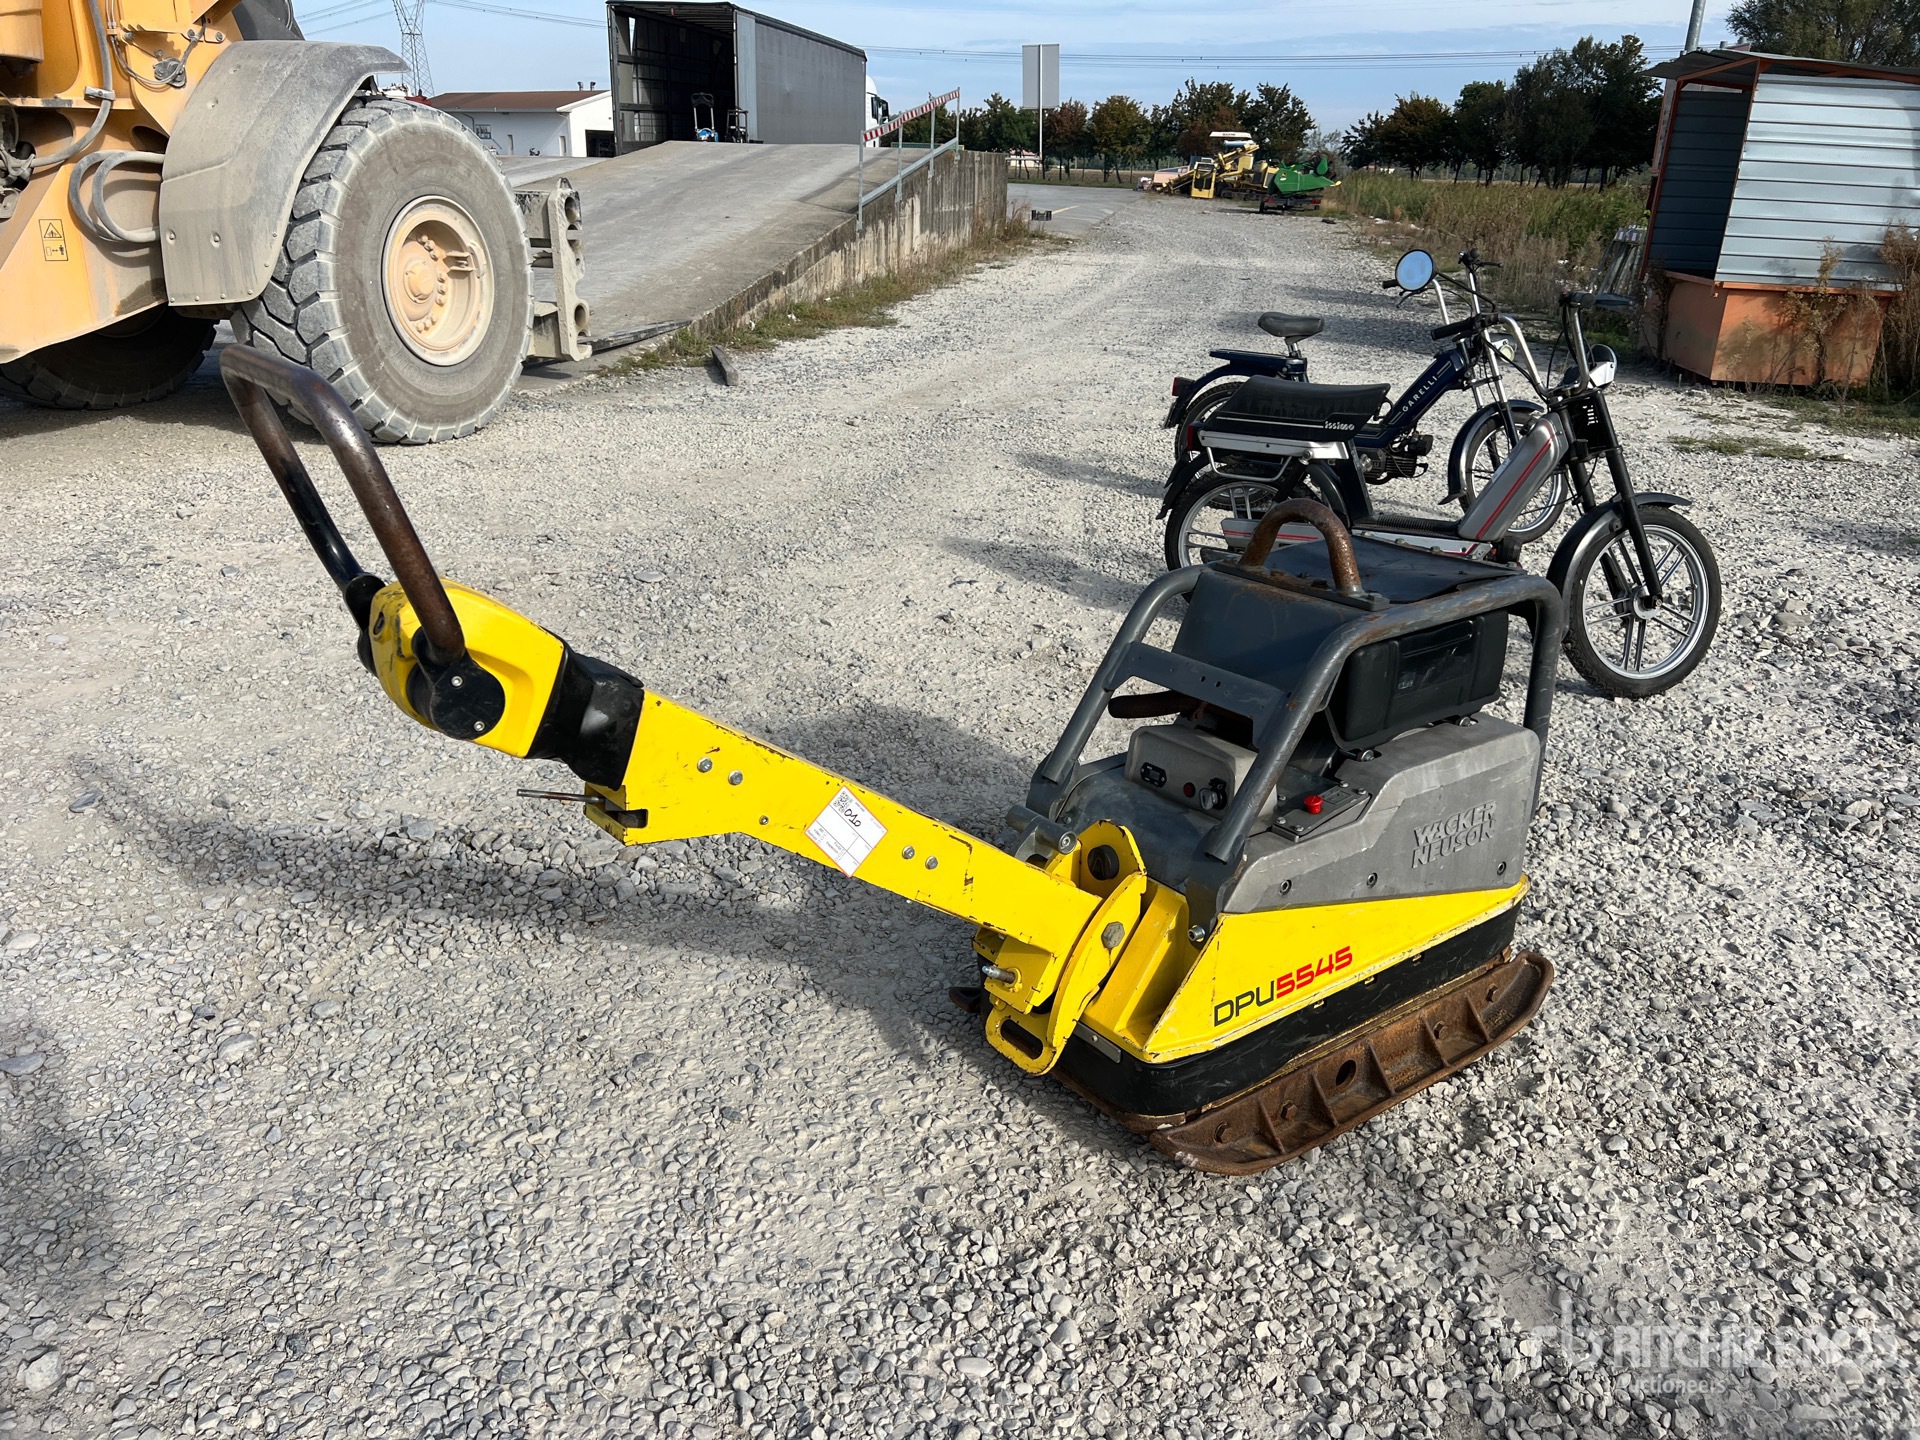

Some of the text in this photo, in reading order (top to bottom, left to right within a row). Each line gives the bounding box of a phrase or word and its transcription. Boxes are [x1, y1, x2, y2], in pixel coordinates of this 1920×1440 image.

[1402, 375, 1438, 412] GARELLI
[1411, 819, 1496, 869] NEUSON
[1413, 800, 1497, 848] WACKER
[1213, 945, 1353, 1027] DPU5545
